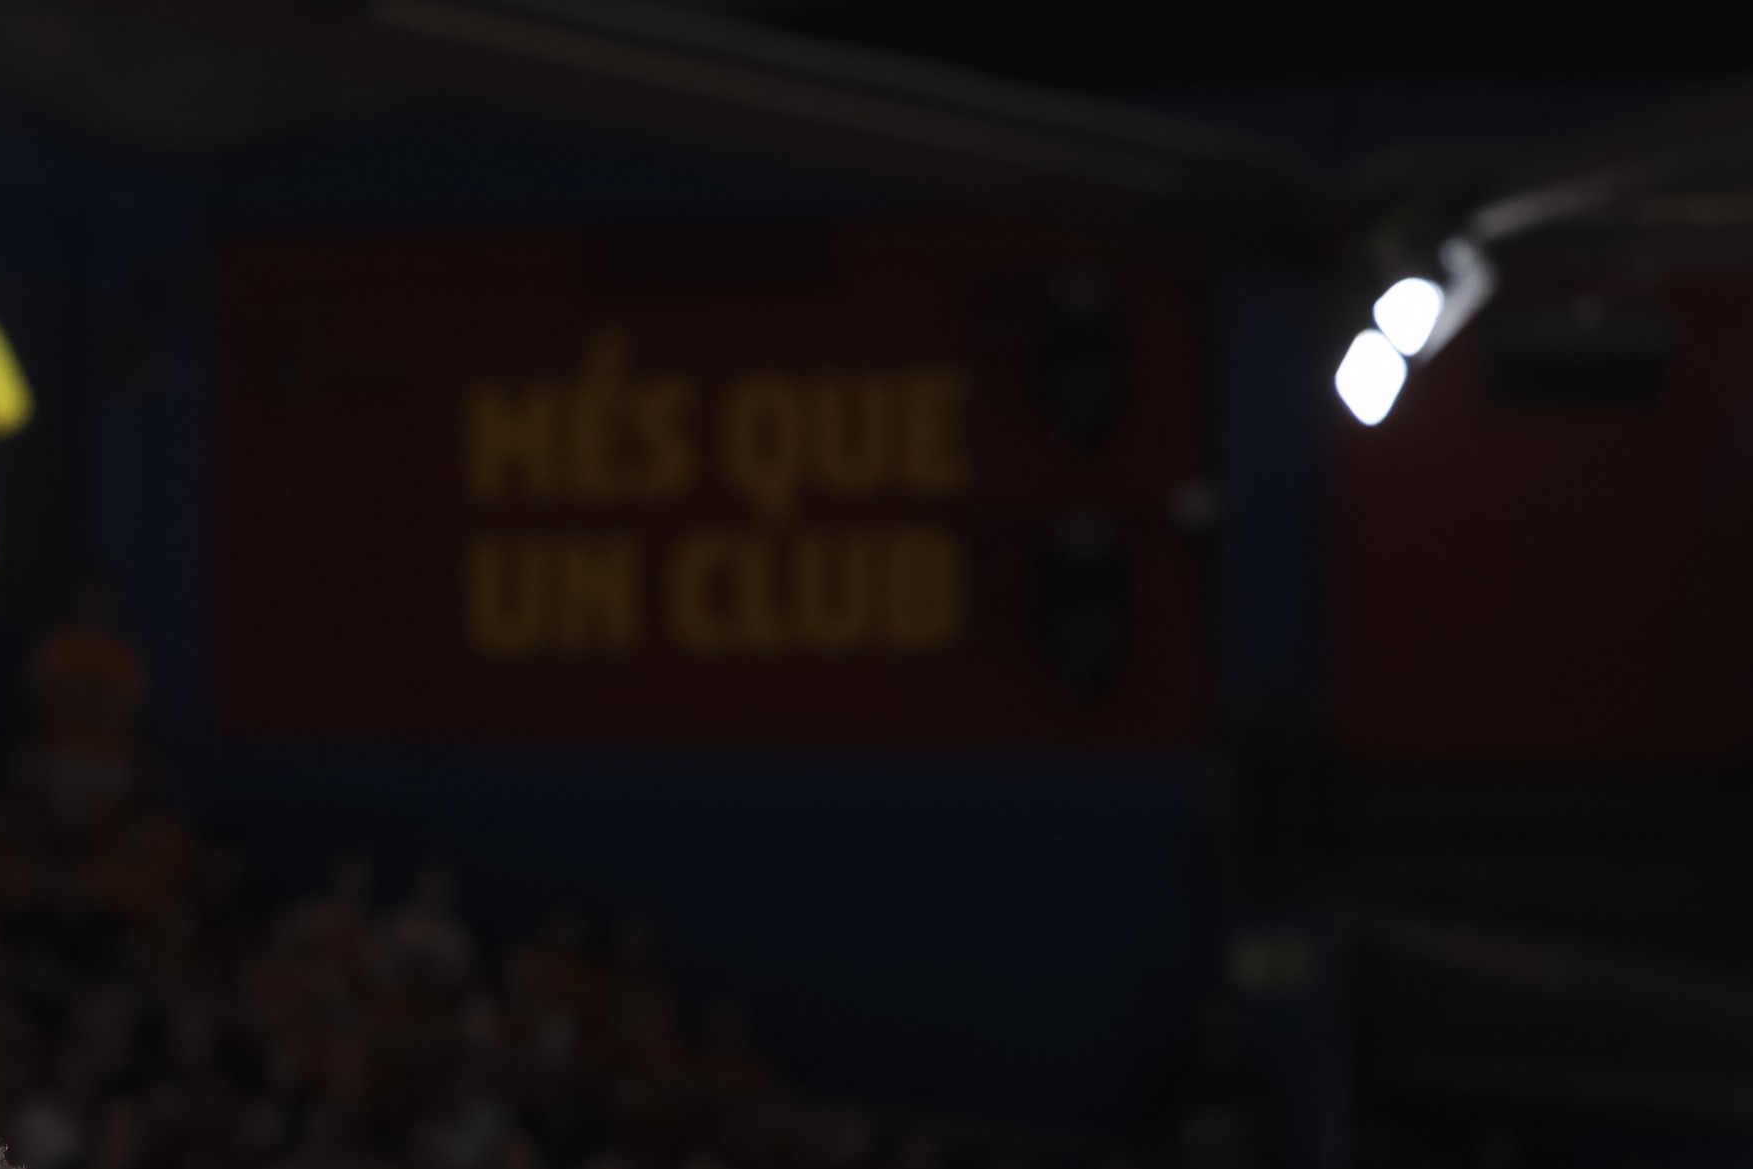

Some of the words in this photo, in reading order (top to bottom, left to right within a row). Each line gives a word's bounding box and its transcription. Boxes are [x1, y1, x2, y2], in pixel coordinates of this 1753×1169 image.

[467, 335, 693, 500] MÉS
[723, 370, 970, 524] QUE
[466, 534, 640, 656] UN
[665, 528, 963, 654] CLUB
